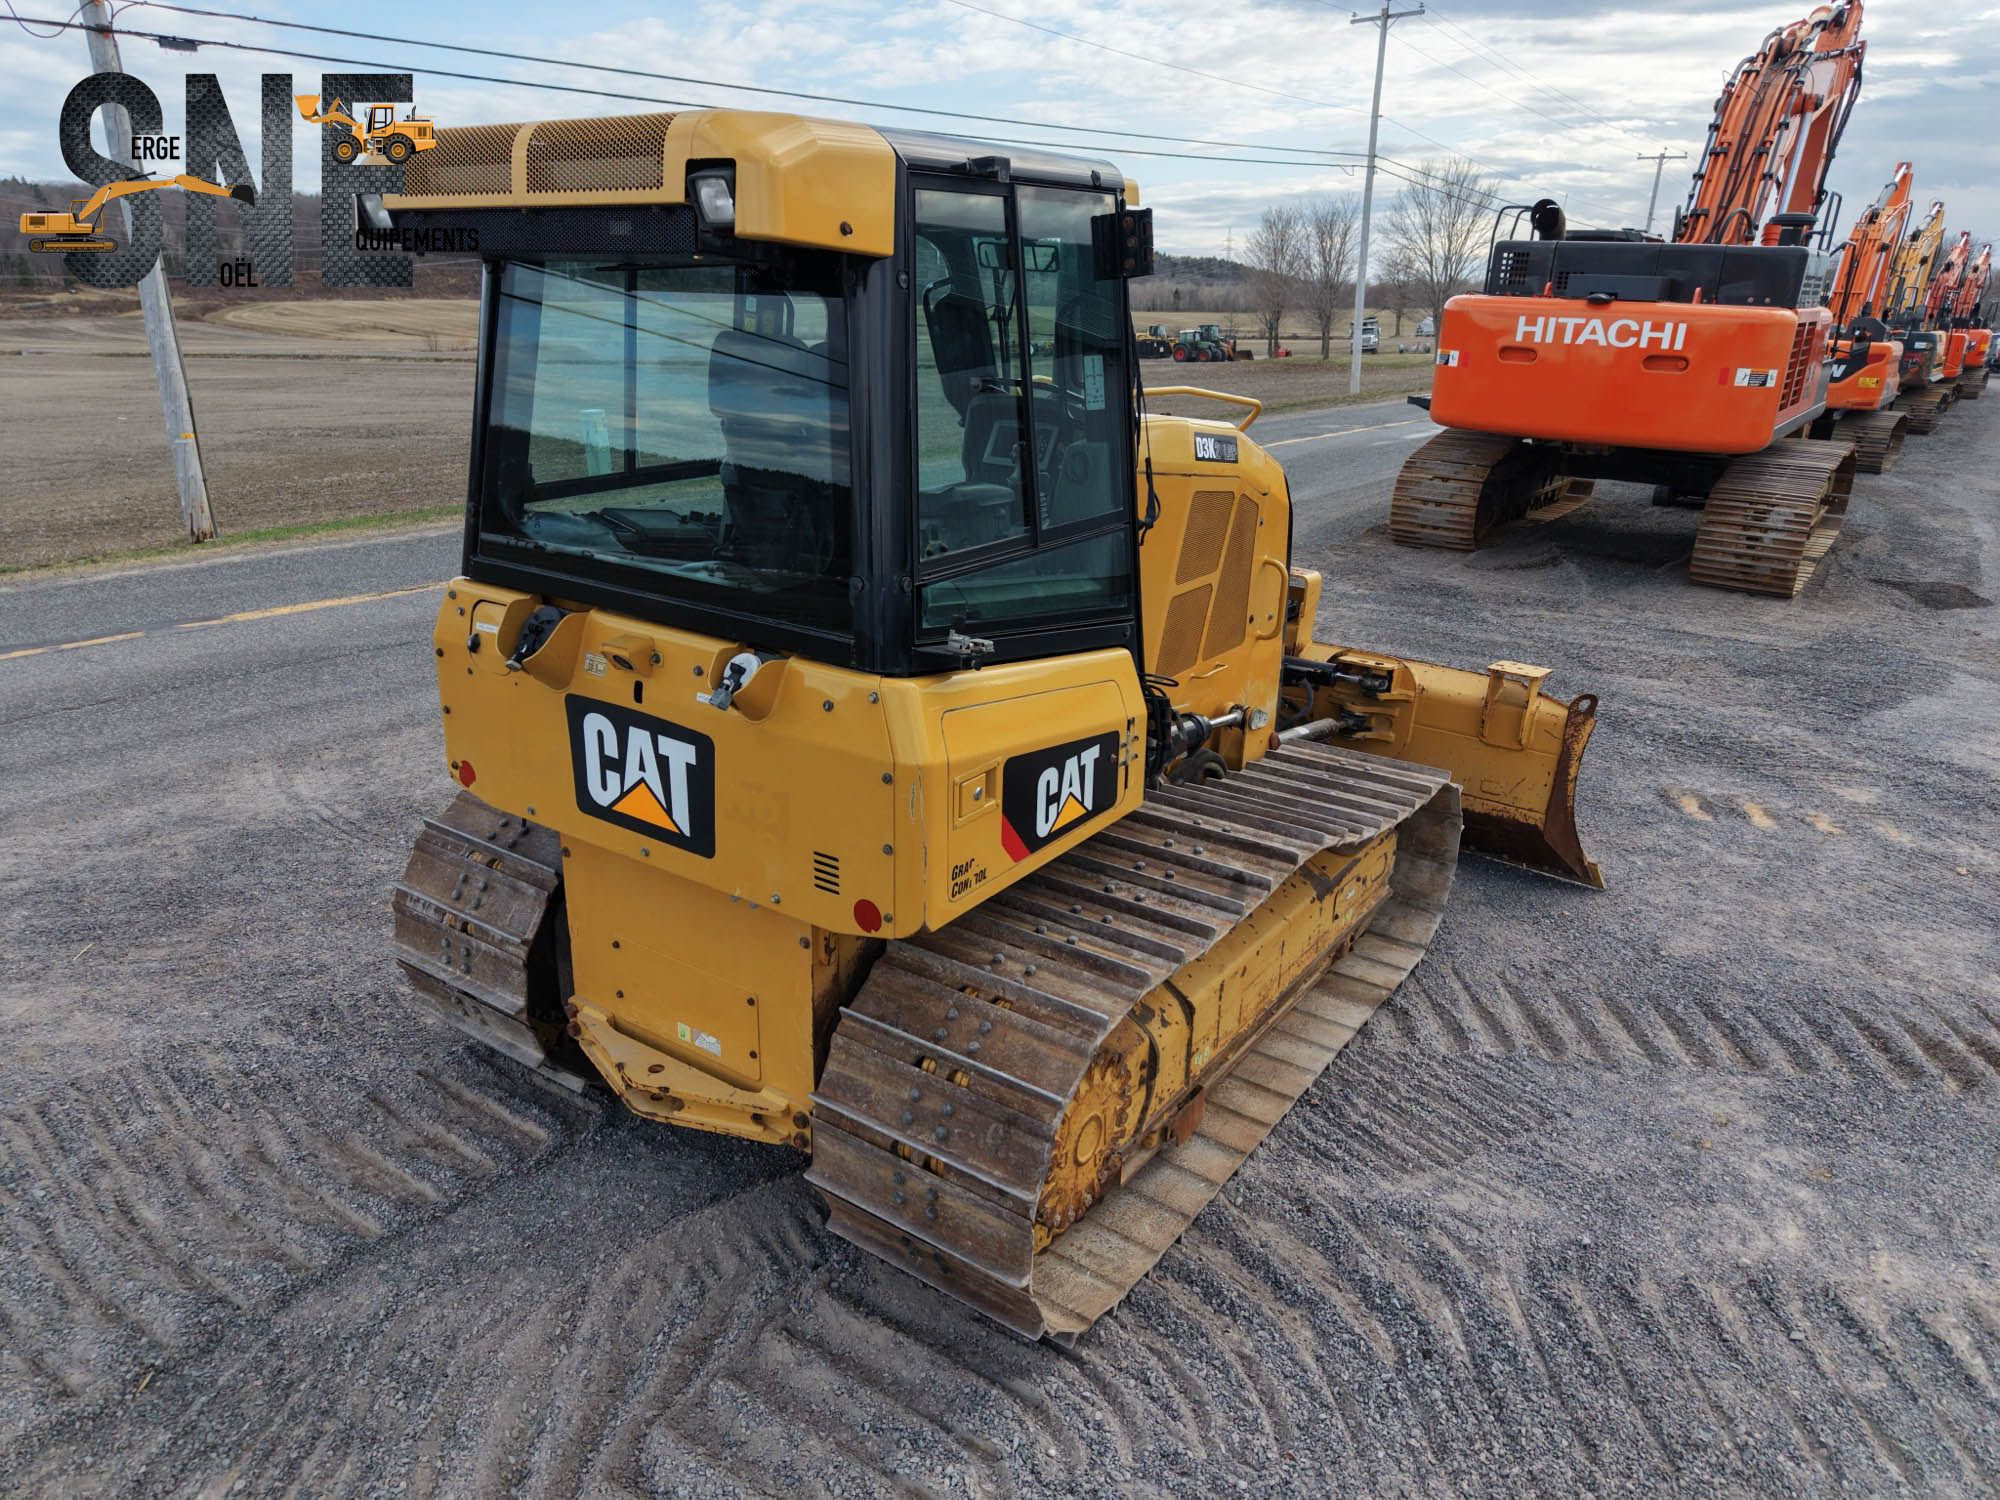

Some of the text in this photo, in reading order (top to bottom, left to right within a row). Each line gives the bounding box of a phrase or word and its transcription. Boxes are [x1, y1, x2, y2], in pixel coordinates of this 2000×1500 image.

[1515, 315, 1687, 350] HITACHI
[583, 712, 697, 838] CAT
[1036, 743, 1100, 838] CAT
